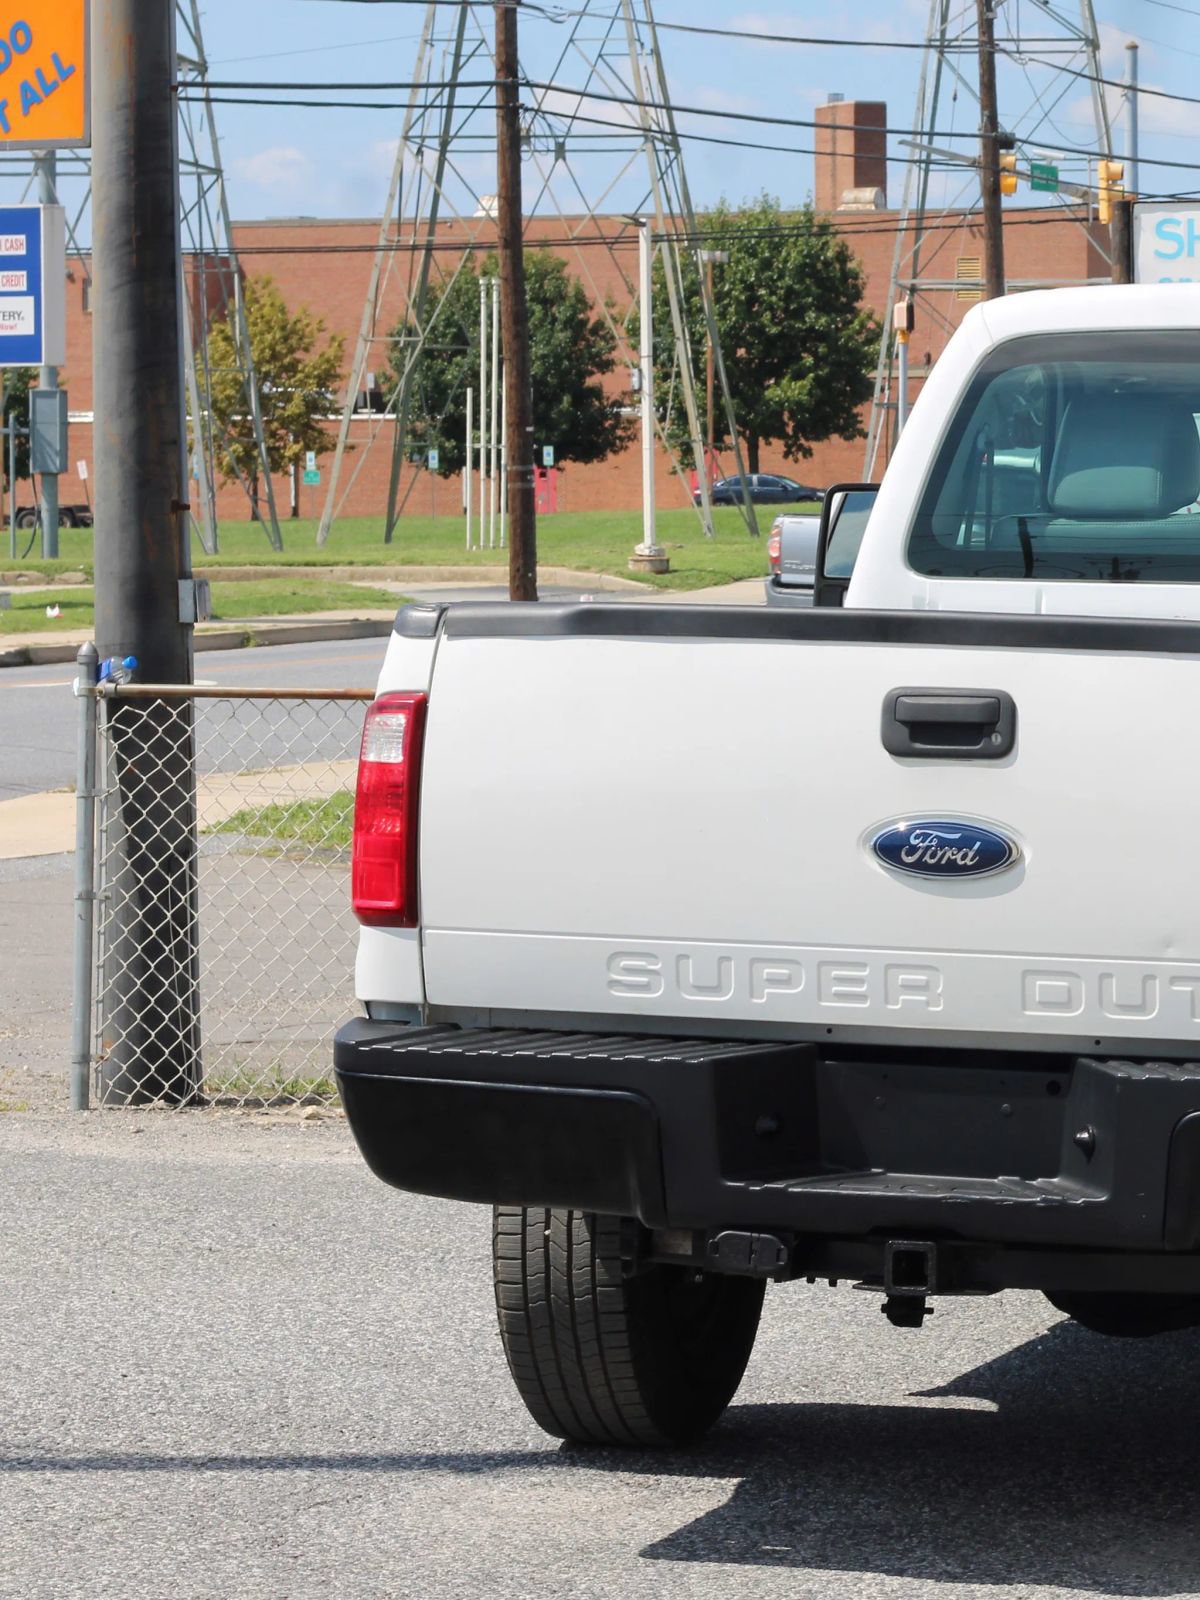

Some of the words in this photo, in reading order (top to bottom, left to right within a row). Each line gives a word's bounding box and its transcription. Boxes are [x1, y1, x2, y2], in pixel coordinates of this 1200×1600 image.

[20, 51, 76, 117] ALL
[4, 237, 25, 252] CASH
[1, 273, 25, 288] CREDIT
[901, 829, 981, 866] Ford
[606, 951, 944, 1011] SUPER
